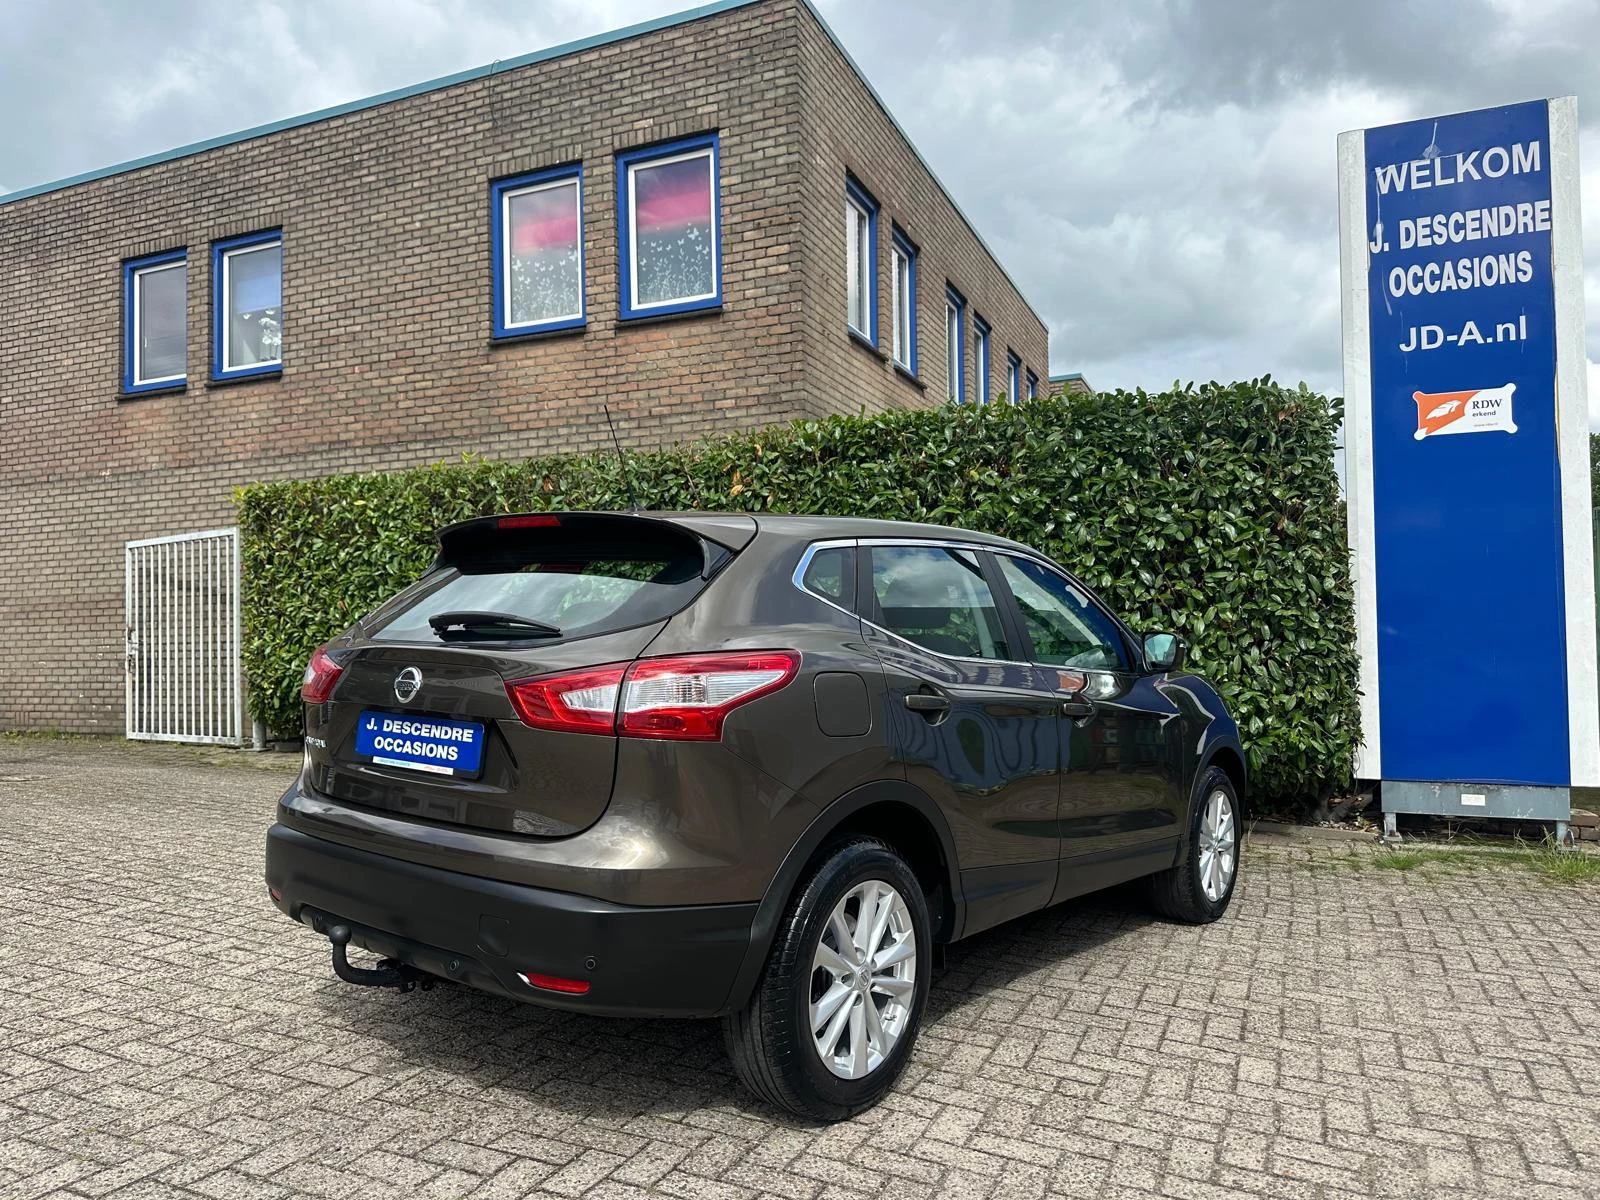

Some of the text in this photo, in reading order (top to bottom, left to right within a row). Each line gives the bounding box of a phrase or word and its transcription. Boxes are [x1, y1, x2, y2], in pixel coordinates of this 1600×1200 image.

[1375, 141, 1541, 194] WELKOM
[1369, 199, 1552, 254] J. DESCENDRE
[1388, 250, 1533, 298] OCCASIONS
[1399, 315, 1527, 352] JD-A.nl
[1471, 398, 1503, 410] RDW
[1471, 410, 1497, 418] erkend
[366, 717, 474, 743] J. DESCENDRE
[373, 736, 459, 761] OCCASIONS
